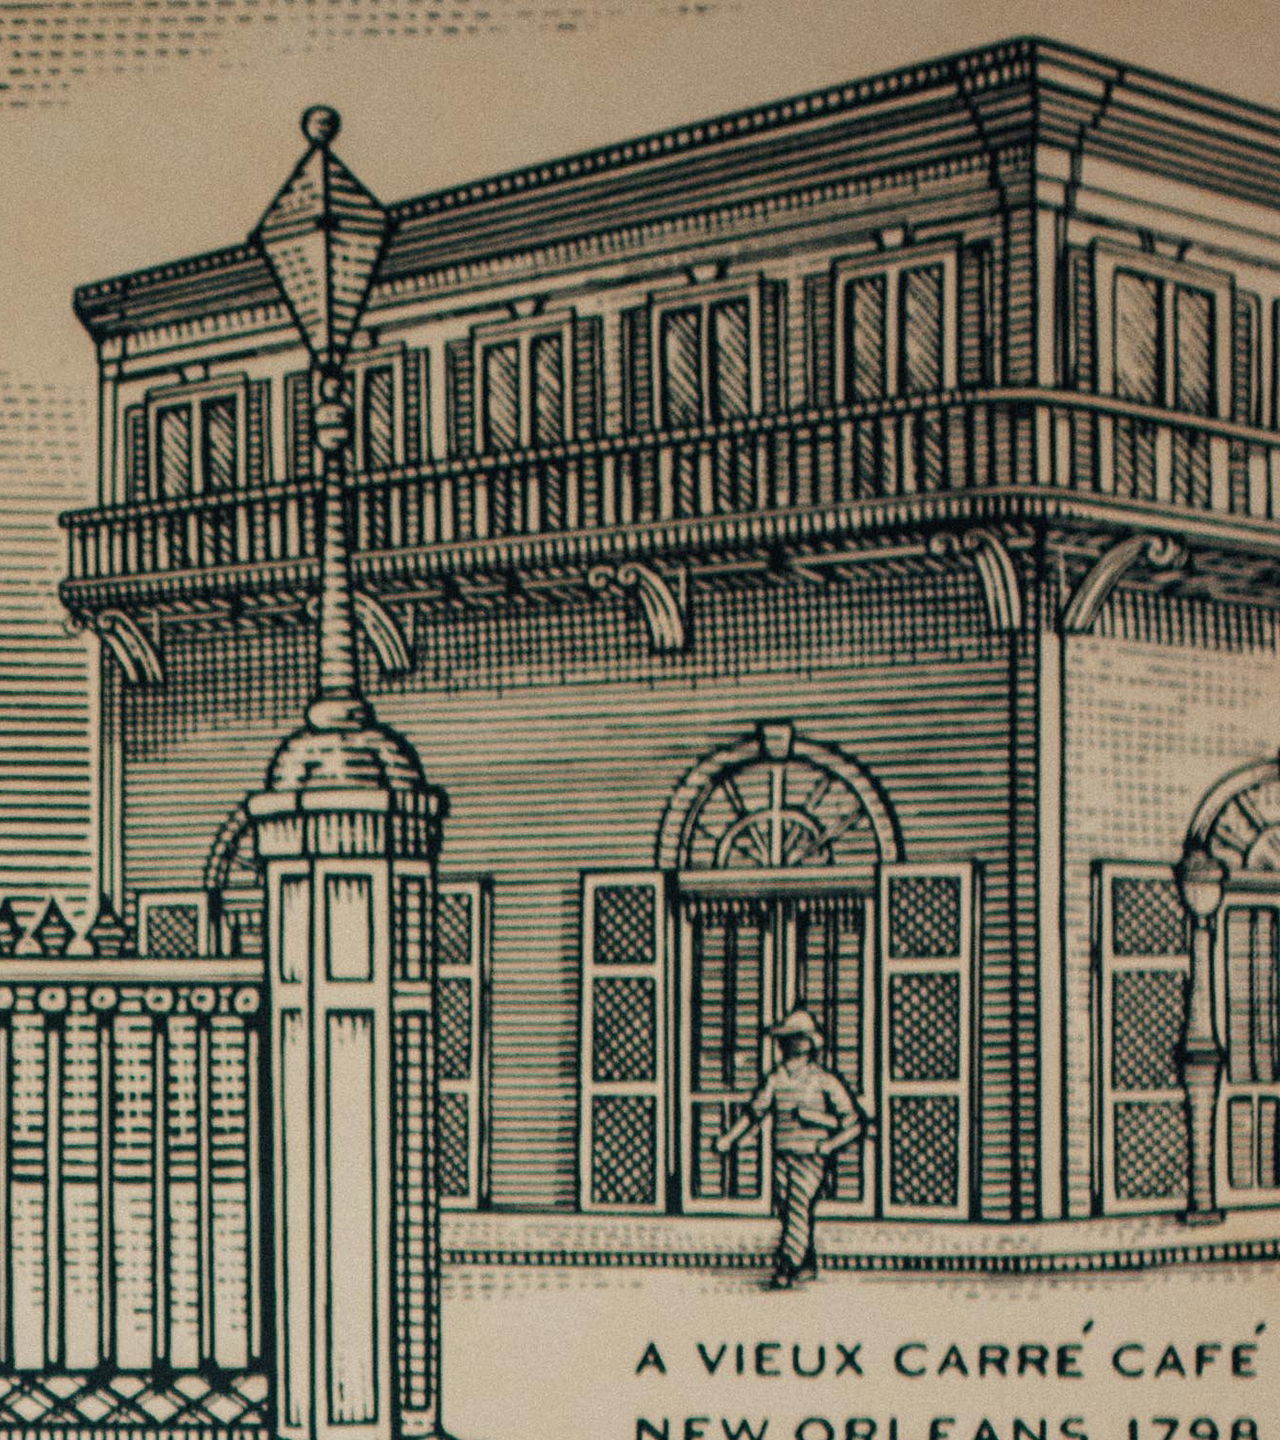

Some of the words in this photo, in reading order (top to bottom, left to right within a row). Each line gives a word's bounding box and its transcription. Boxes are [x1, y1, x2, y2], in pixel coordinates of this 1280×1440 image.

[635, 1340, 667, 1376] A
[696, 1340, 864, 1378] VIEUX
[893, 1319, 1094, 1378] CARRÉ
[1111, 1321, 1267, 1378] CAFÉ
